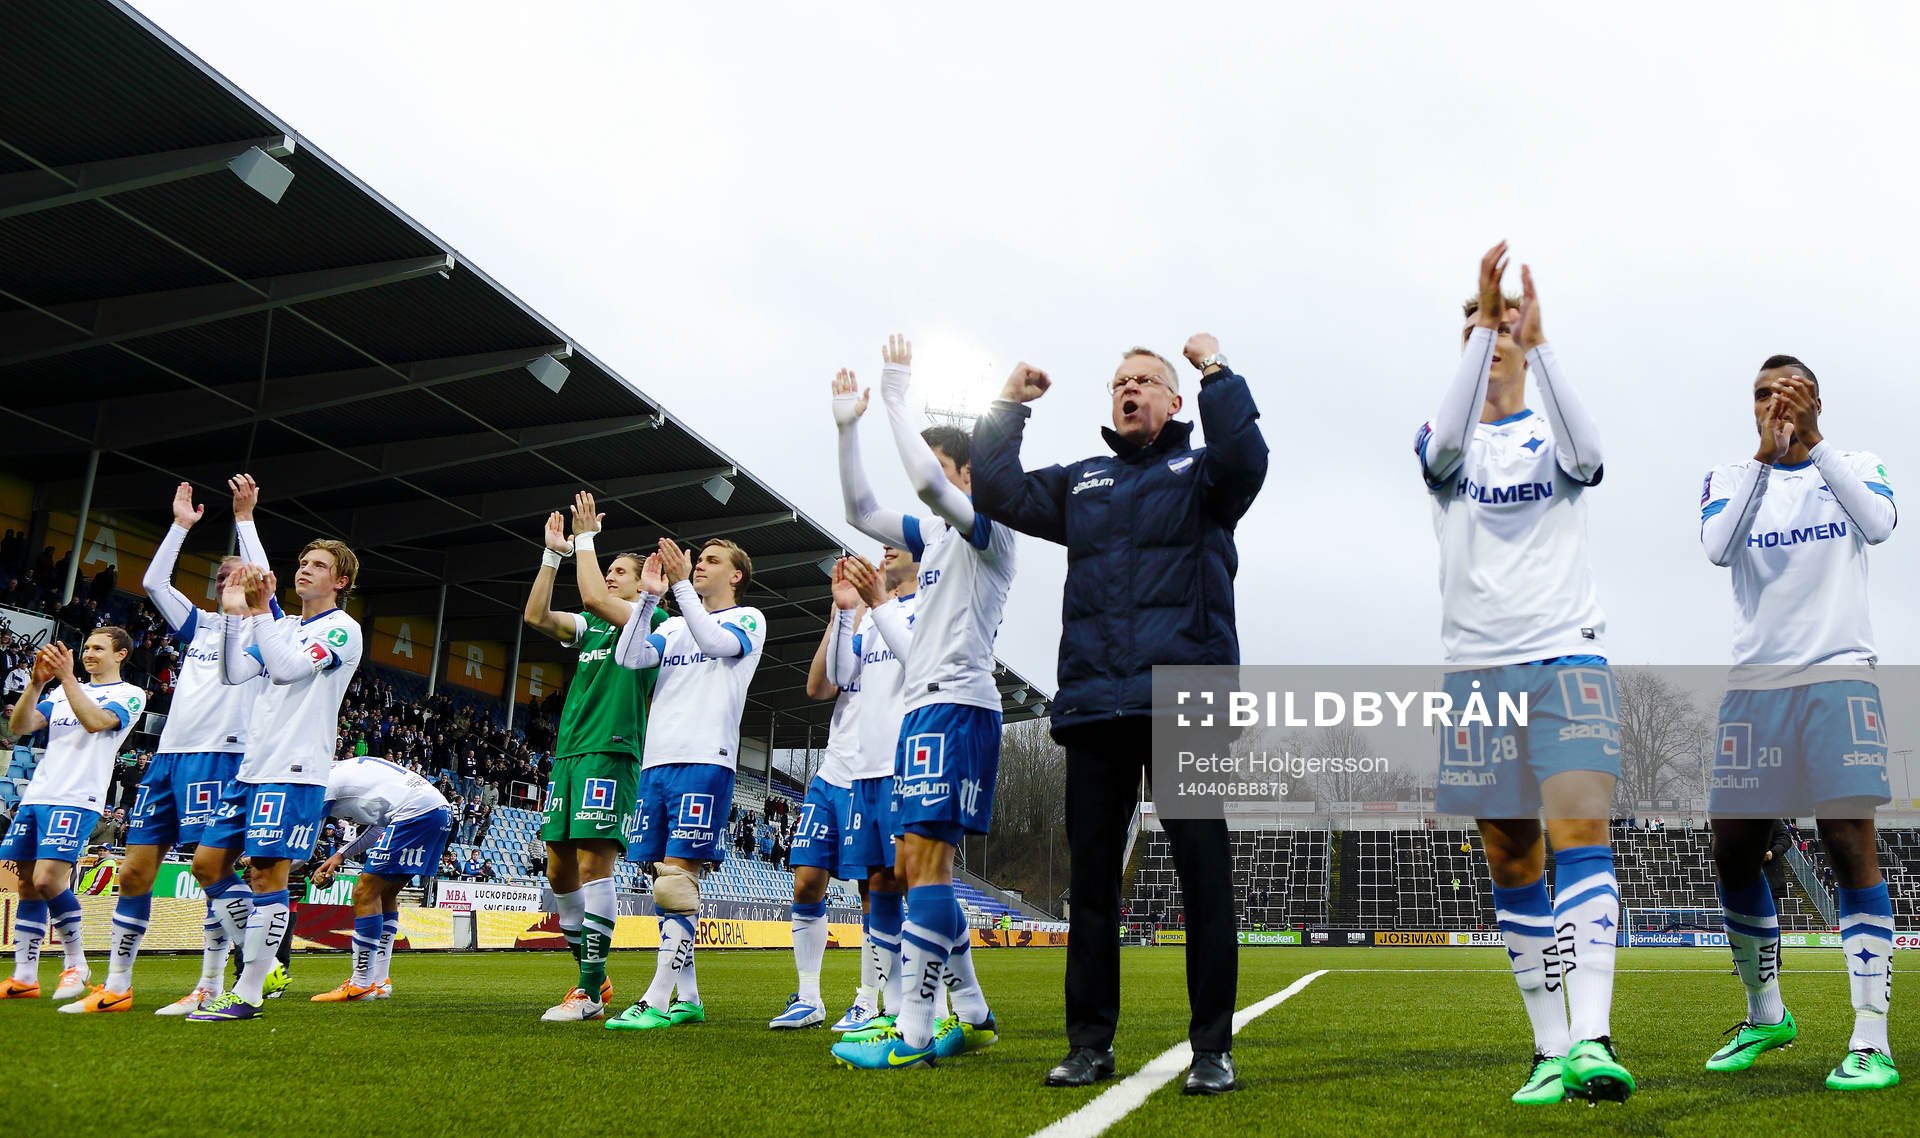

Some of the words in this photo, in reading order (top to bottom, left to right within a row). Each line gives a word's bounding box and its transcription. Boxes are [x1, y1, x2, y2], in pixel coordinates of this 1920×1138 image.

[1072, 478, 1115, 495] stadium
[1456, 477, 1553, 504] HOLMEN
[1747, 521, 1847, 548] HOLMEN
[1491, 734, 1518, 764] 28
[1757, 747, 1782, 768] 20
[1843, 751, 1887, 767] stadi
[1440, 769, 1497, 787] stadium
[1713, 775, 1759, 789] adium
[216, 801, 238, 818] 26
[551, 797, 563, 812] 91
[574, 810, 617, 823] stadium
[13, 823, 28, 836] 15
[671, 828, 714, 841] stadium
[811, 821, 828, 839] 13
[40, 836, 79, 848] stadium
[445, 889, 467, 902] MBA
[266, 911, 287, 948] SITA
[1248, 934, 1295, 943] Ekbacken
[1380, 933, 1446, 944] JOBMAN
[1472, 933, 1504, 942] BEIJ
[27, 937, 42, 962] SITA
[116, 932, 138, 958] SITA
[586, 932, 602, 961] SITA
[1555, 922, 1577, 976] SITA
[1781, 936, 1807, 945] SEB
[671, 938, 691, 974] SITA
[1759, 942, 1777, 984] SITA
[1542, 944, 1563, 993] SITA
[920, 961, 943, 1003] SITA
